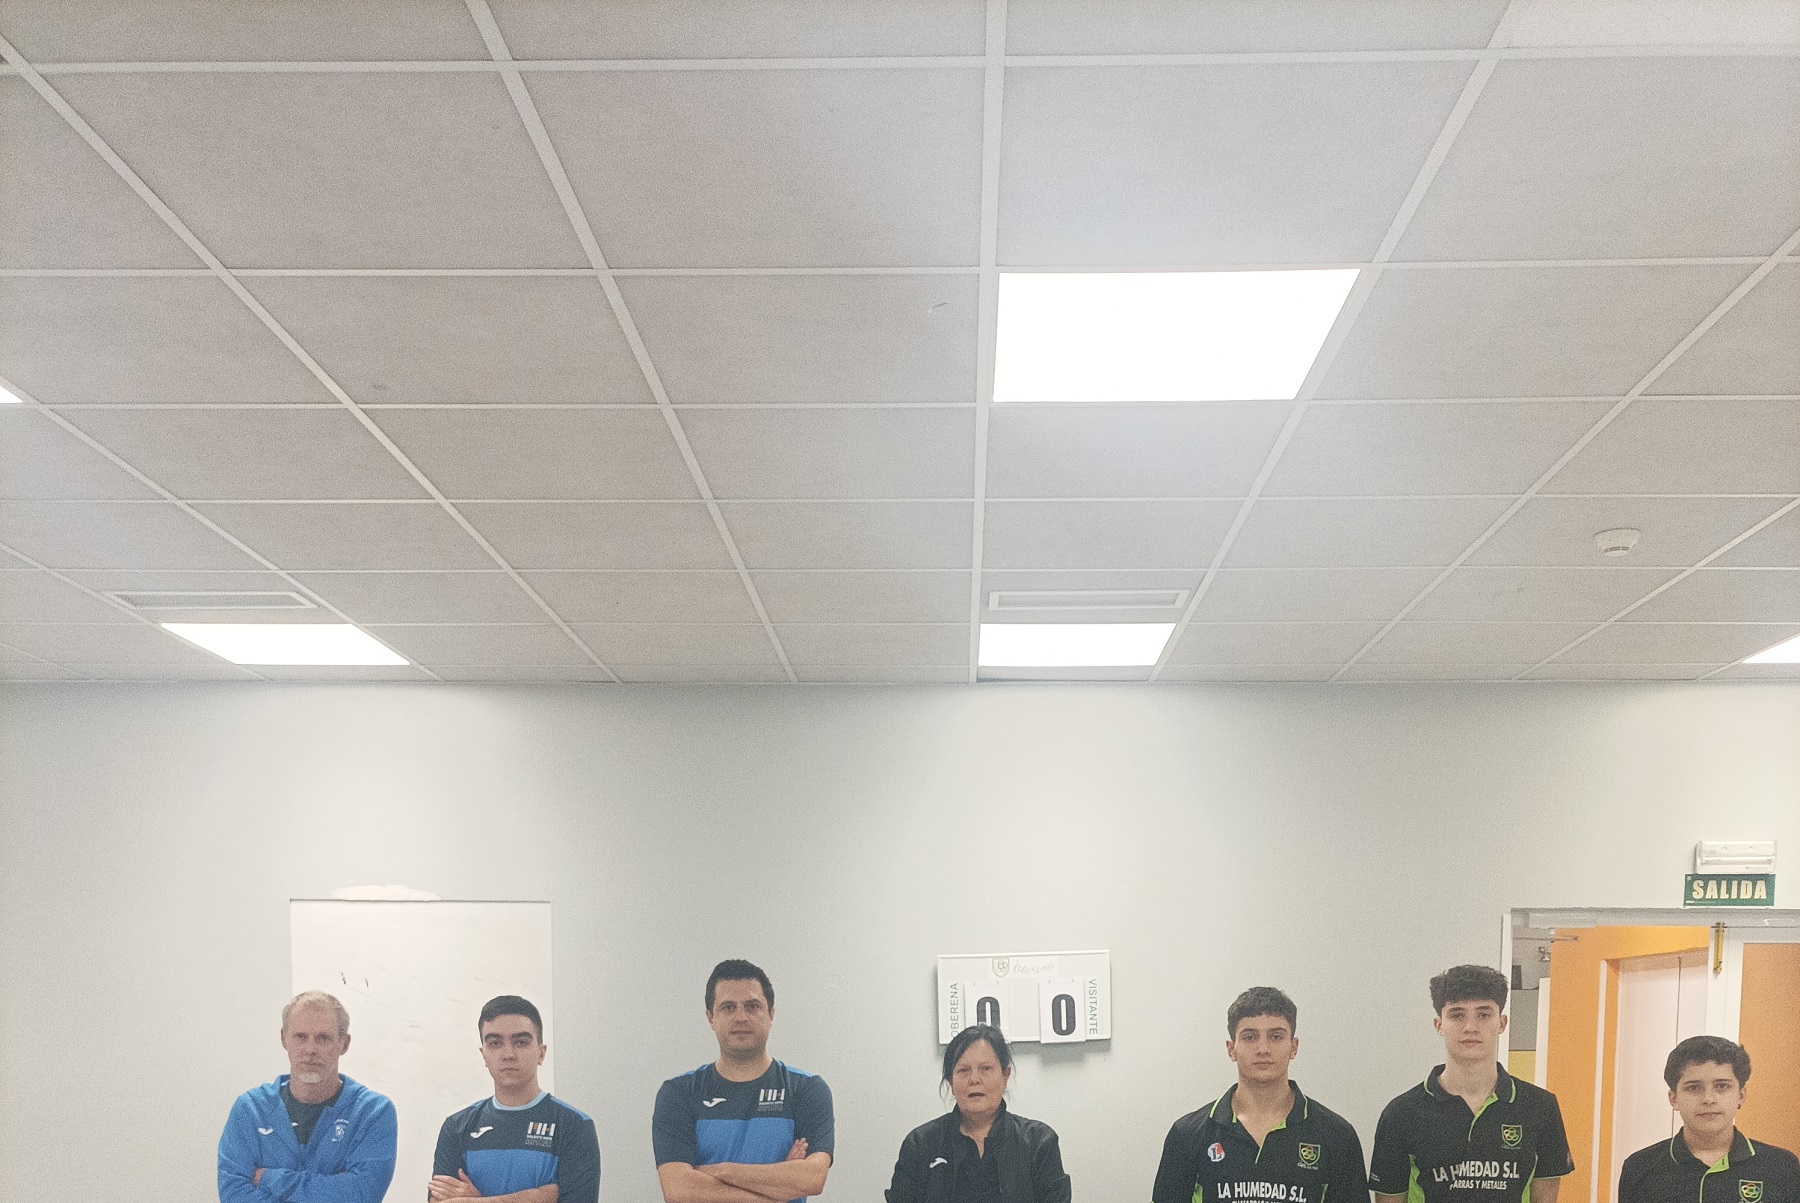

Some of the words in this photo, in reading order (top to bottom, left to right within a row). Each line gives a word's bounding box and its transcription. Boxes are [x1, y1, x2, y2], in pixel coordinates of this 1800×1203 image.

[1692, 880, 1767, 899] SALIDA
[950, 982, 960, 1038] OBERENA
[1052, 993, 1076, 1036] 0
[1088, 978, 1098, 1035] VISITANTE
[1432, 1166, 1449, 1182] LA
[1450, 1160, 1500, 1180] HMEDAD
[1217, 1182, 1232, 1198] LA
[1234, 1181, 1287, 1200] HUMEDAD
[1481, 1180, 1507, 1190] METALES
